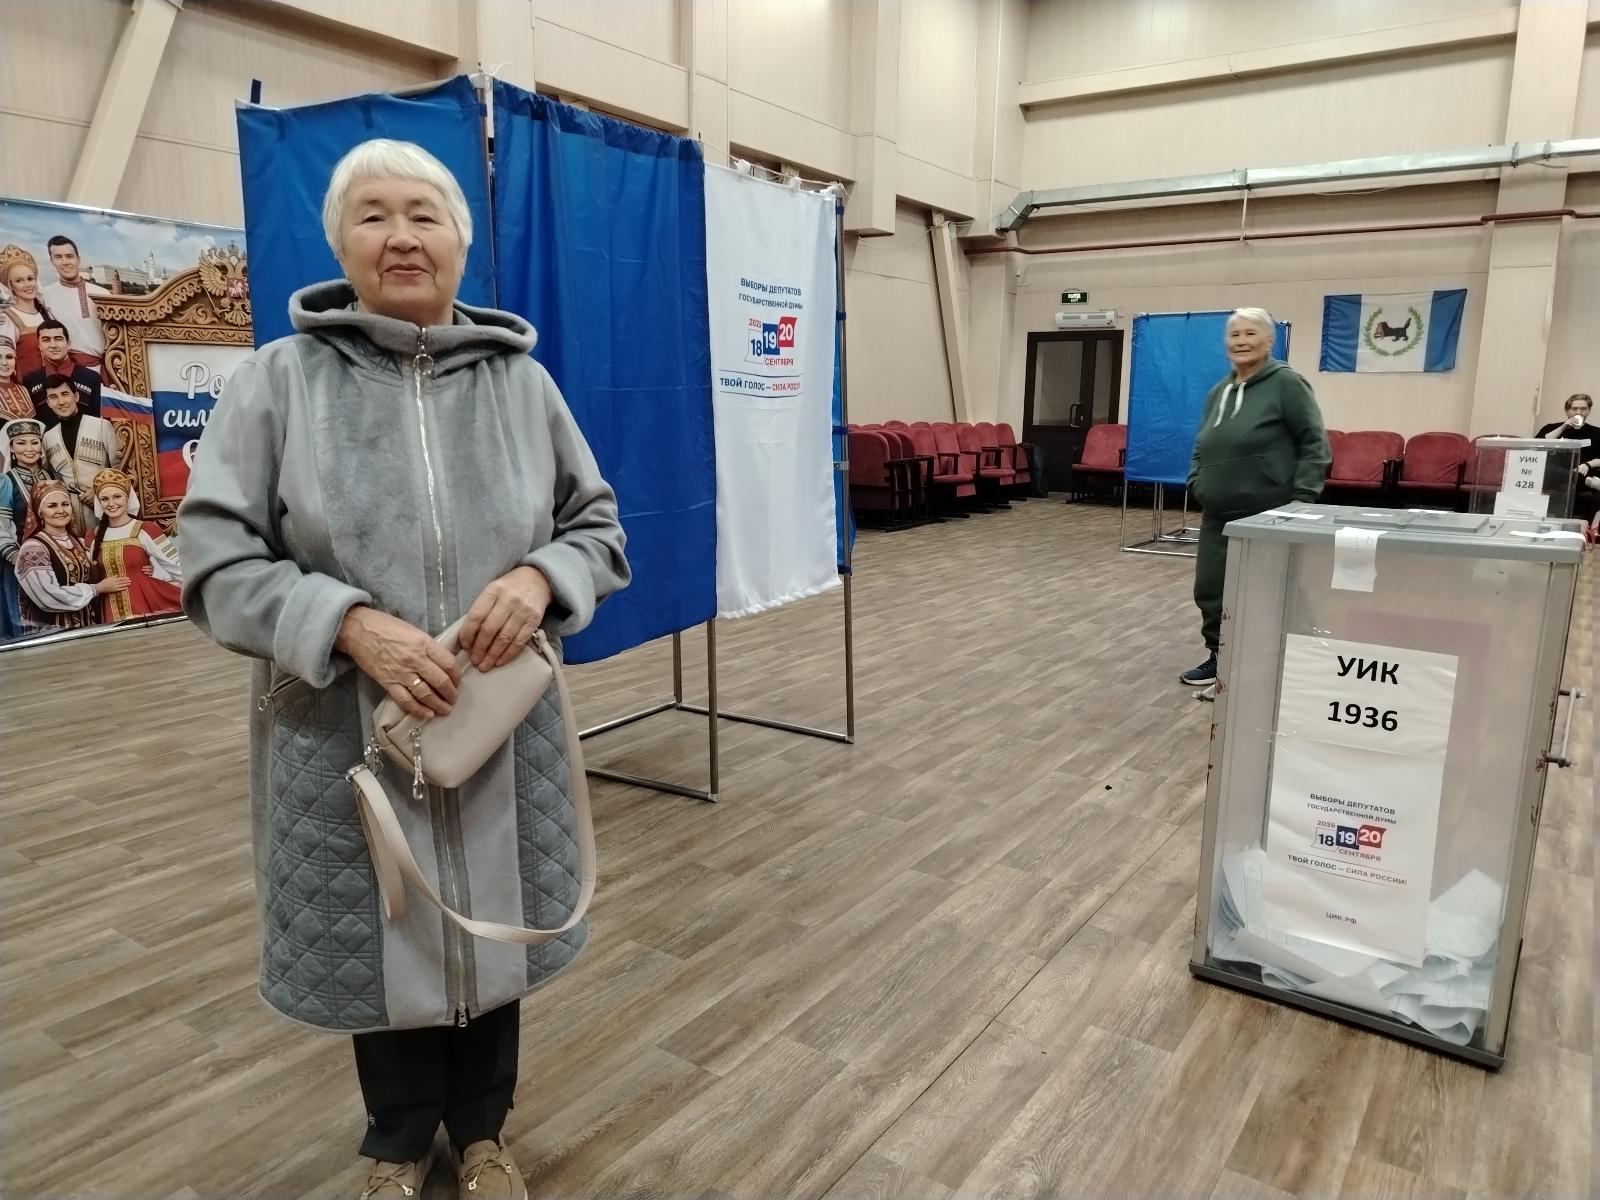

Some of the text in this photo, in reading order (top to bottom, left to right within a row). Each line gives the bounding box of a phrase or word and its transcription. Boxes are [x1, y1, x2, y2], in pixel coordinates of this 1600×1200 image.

[740, 278, 802, 296] ВЫБОРЫ ДЕПУТАТОВ
[751, 323, 794, 357] 18 19 20
[764, 358, 794, 366] СЕНТЯБРЯ
[719, 377, 742, 388] ТВОЙ
[744, 380, 765, 391] ГОЛОС
[1515, 480, 1535, 489] 428
[1337, 655, 1400, 685] УИК
[1327, 701, 1398, 732] 1936
[1307, 803, 1397, 825] ГОСУДАРСТВЕННОЙ ДУМЫ
[1310, 793, 1396, 815] ВЫБОРЫ ДЕПУТАТОВ
[1318, 830, 1381, 847] 18 19 20
[1338, 848, 1382, 862] СЕНТЯБРЯ
[1287, 854, 1309, 865] ТВОЙ
[1310, 859, 1337, 871] ГОЛОС
[1345, 867, 1368, 878] СИЛА
[1370, 872, 1408, 886] РОССИИ!
